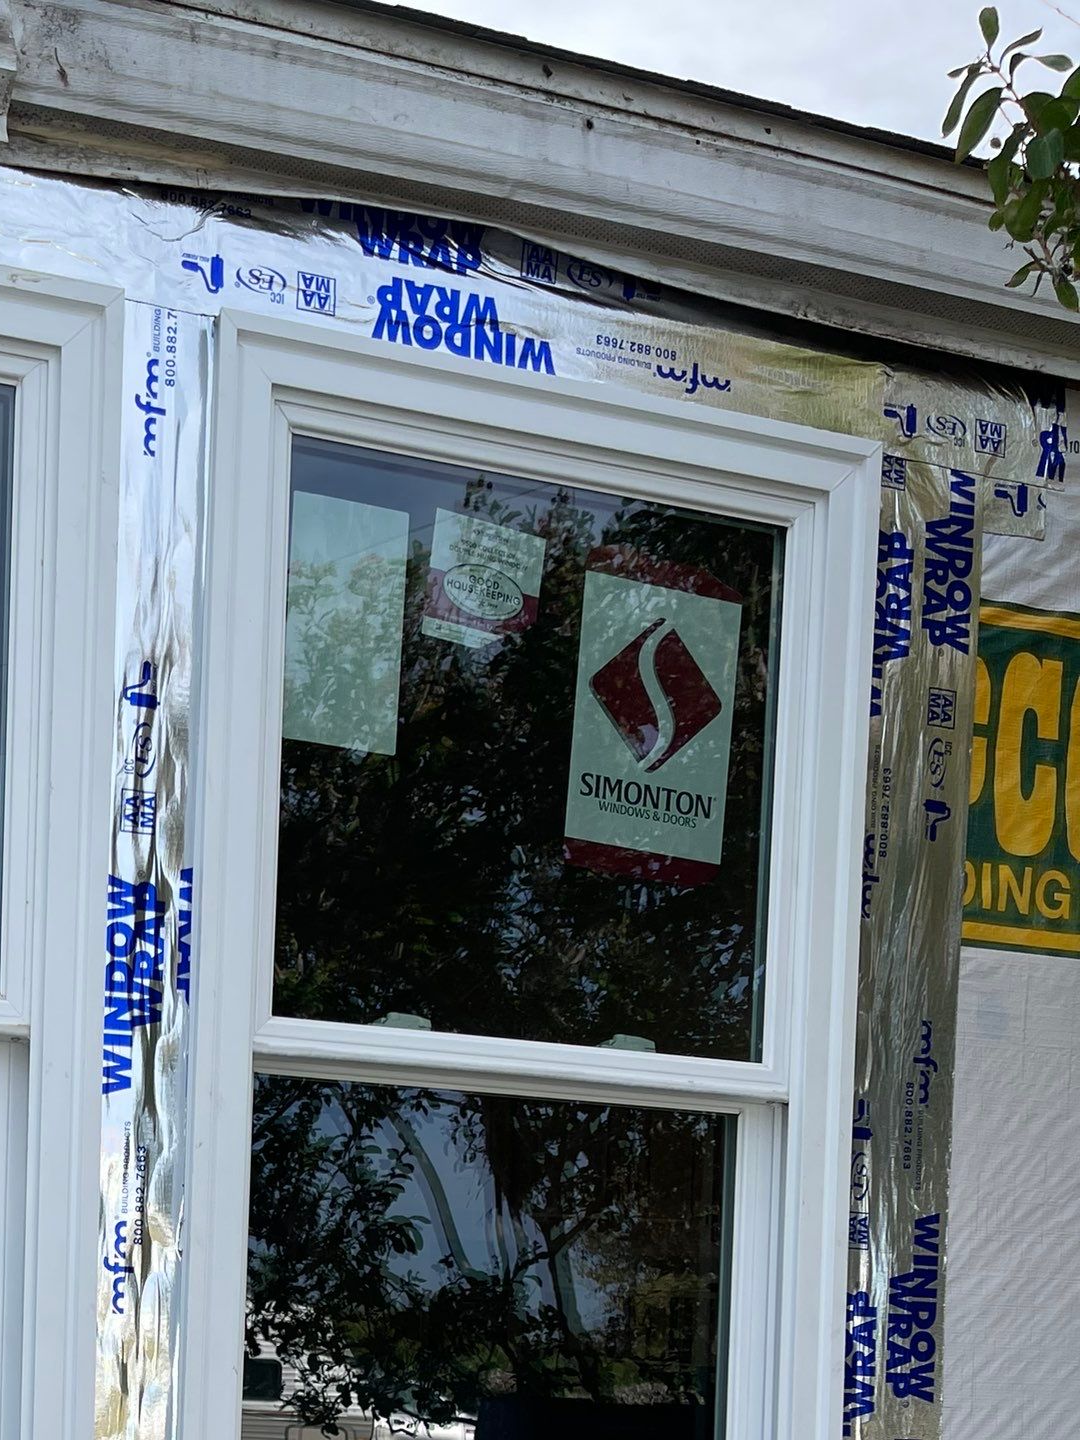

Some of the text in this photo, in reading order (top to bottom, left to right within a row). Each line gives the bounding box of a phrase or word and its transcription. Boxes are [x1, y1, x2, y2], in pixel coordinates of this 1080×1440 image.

[248, 268, 274, 290] ES
[270, 292, 285, 305] ICC
[376, 276, 500, 333] WRAP
[134, 309, 167, 458] mfm BUILDING
[372, 308, 556, 376] WINDOW
[576, 347, 732, 394] mfm BUILDING PRODUCTS
[596, 334, 677, 361] 800.882.7663
[447, 579, 521, 606] HOUSEKEEPING
[469, 575, 500, 590] GOOD
[886, 531, 914, 663] WRAP
[921, 517, 952, 648] WRAP
[944, 468, 976, 656] WINDOW
[580, 772, 713, 819] SIMONTON
[598, 800, 697, 829] WINDOWS & DOORS
[879, 768, 892, 857] 800.882.7663
[102, 874, 138, 1095] WINDOW
[132, 880, 166, 1030] WRAP
[913, 1020, 938, 1105] mfm
[903, 1081, 915, 1170] 800.882.7663
[103, 1220, 135, 1315] mfm
[910, 1213, 941, 1404] WINDOW
[852, 1291, 878, 1419] WRAP
[886, 1271, 912, 1400] WRAP
